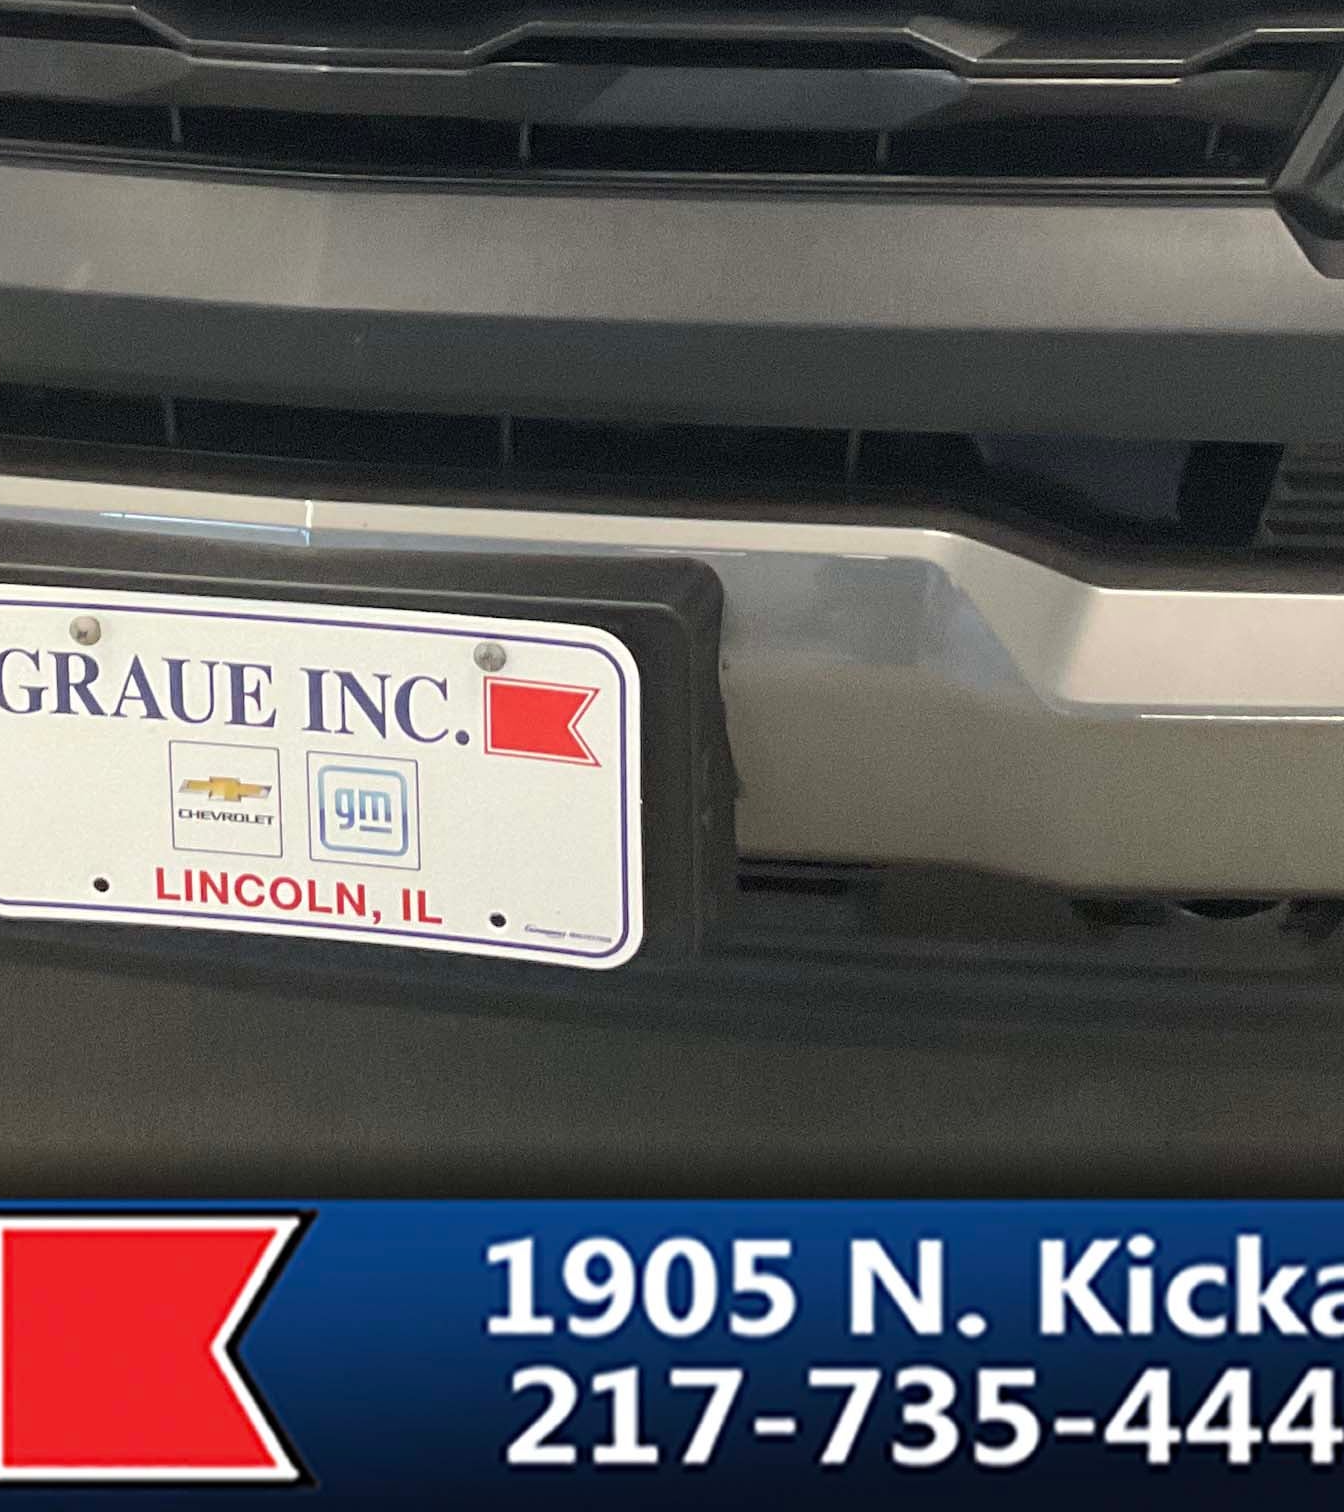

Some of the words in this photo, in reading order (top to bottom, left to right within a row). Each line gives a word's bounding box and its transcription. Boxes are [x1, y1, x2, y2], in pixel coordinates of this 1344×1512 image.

[299, 666, 472, 746] INC.
[177, 807, 275, 826] CHEVROLET
[333, 787, 393, 830] gm
[155, 866, 382, 925] LINCOLN,
[401, 887, 443, 925] IL
